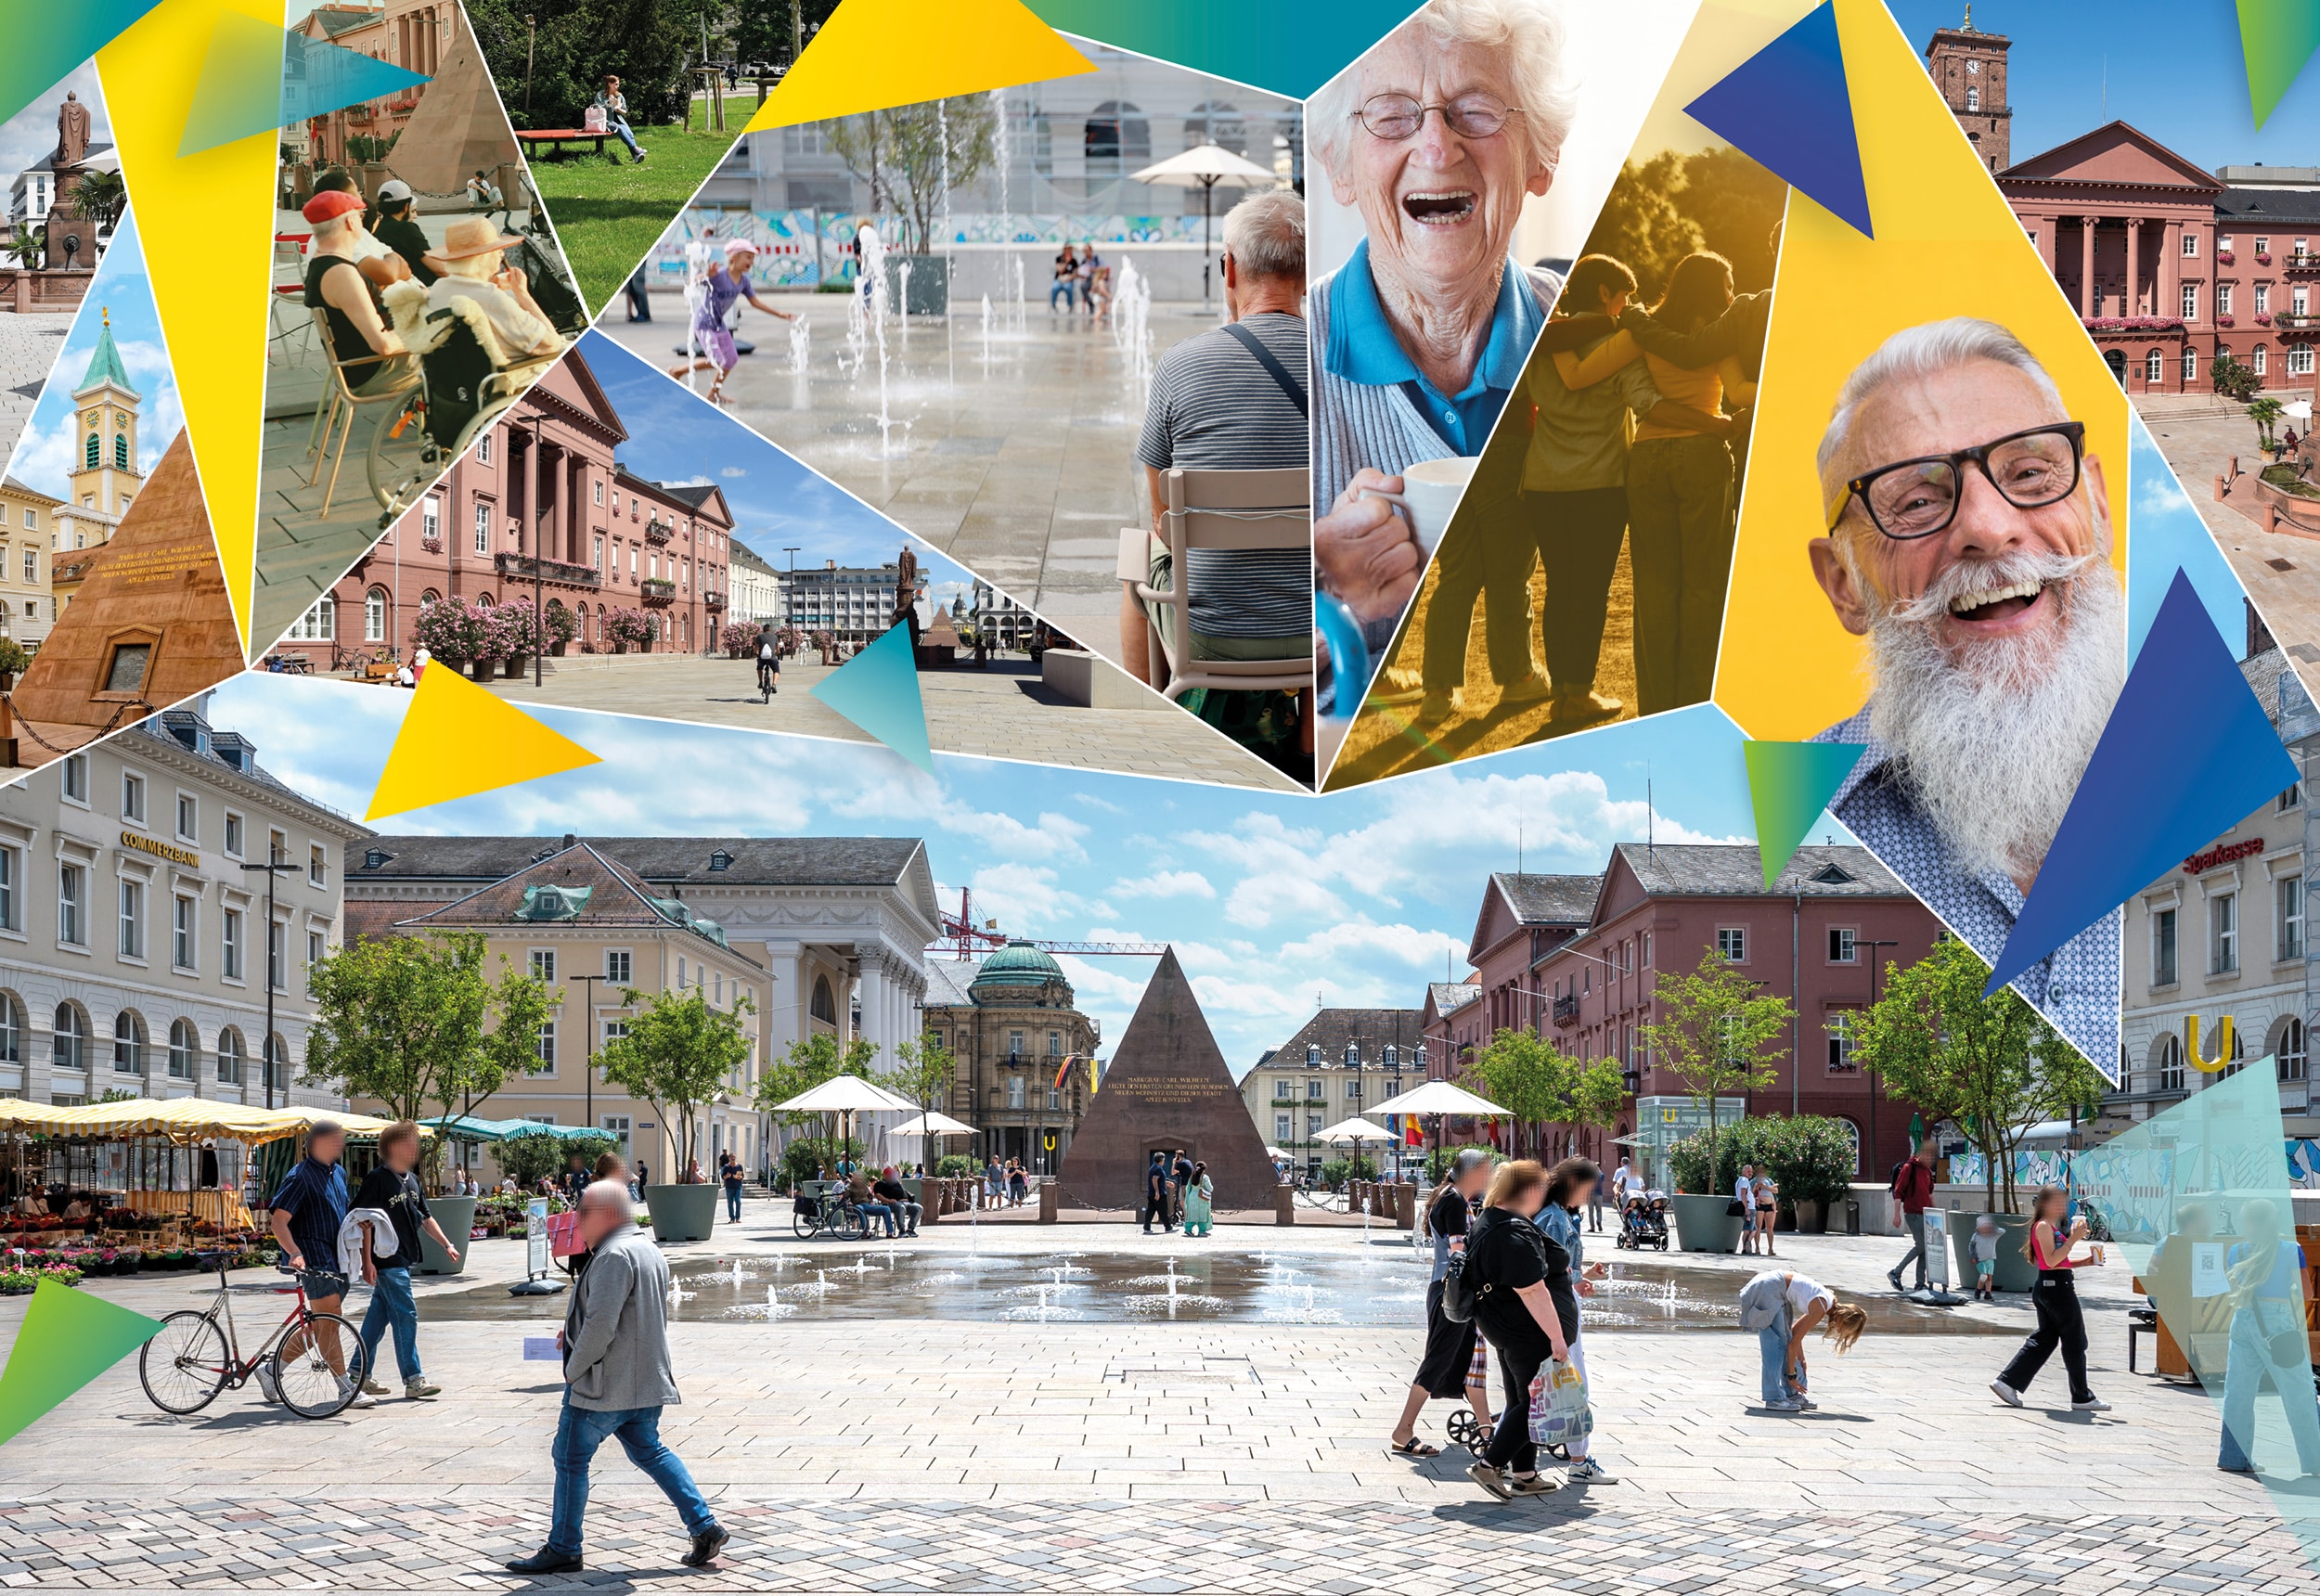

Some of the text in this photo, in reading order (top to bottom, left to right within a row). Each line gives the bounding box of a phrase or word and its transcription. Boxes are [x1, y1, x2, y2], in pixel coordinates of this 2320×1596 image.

[151, 548, 167, 557] CARL
[150, 565, 165, 573] UND
[188, 559, 213, 568] STADT
[121, 830, 200, 868] COMMERZBANK
[2183, 837, 2264, 875] Sparkasse
[2184, 1014, 2233, 1073] U
[1664, 1108, 1676, 1123] U
[1044, 1135, 1056, 1151] U
